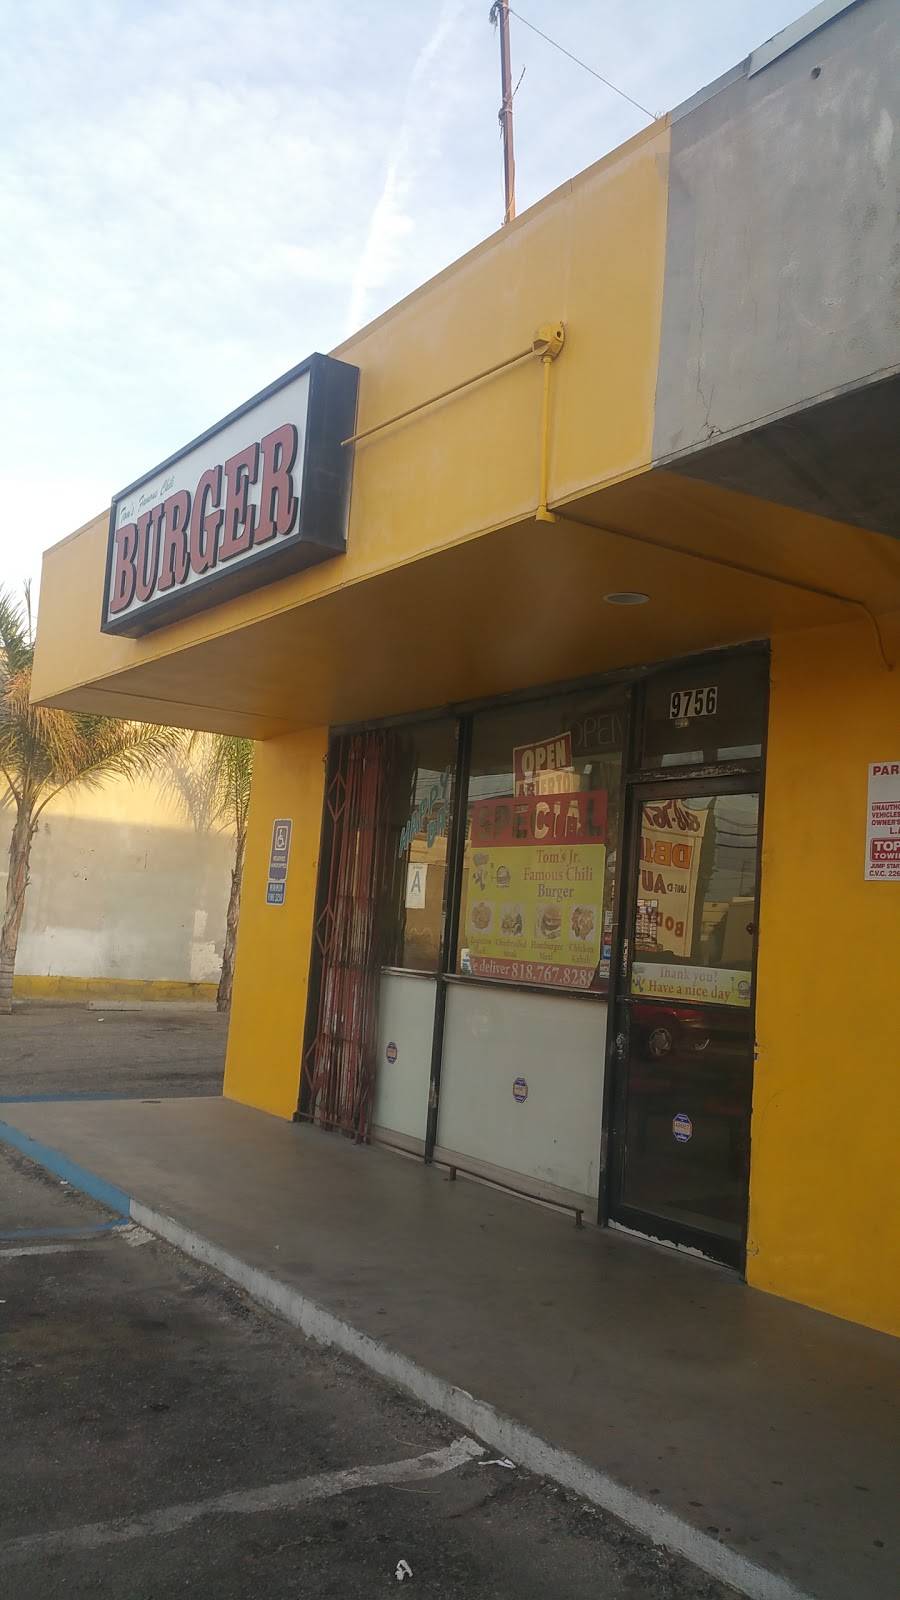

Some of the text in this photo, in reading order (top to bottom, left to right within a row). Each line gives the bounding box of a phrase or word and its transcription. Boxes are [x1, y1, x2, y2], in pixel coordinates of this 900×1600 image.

[109, 422, 299, 614] BURGER
[671, 687, 716, 718] 9756
[521, 739, 566, 776] OPEN
[477, 798, 603, 841] SPECIAL
[536, 848, 567, 865] Tom's
[873, 841, 900, 852] TOP
[411, 870, 421, 893] A
[522, 864, 593, 882] Famous Chili
[537, 883, 575, 903] Burger
[479, 959, 509, 976] deliver
[659, 966, 690, 981] Thank
[648, 979, 731, 1002] Have a nice day
